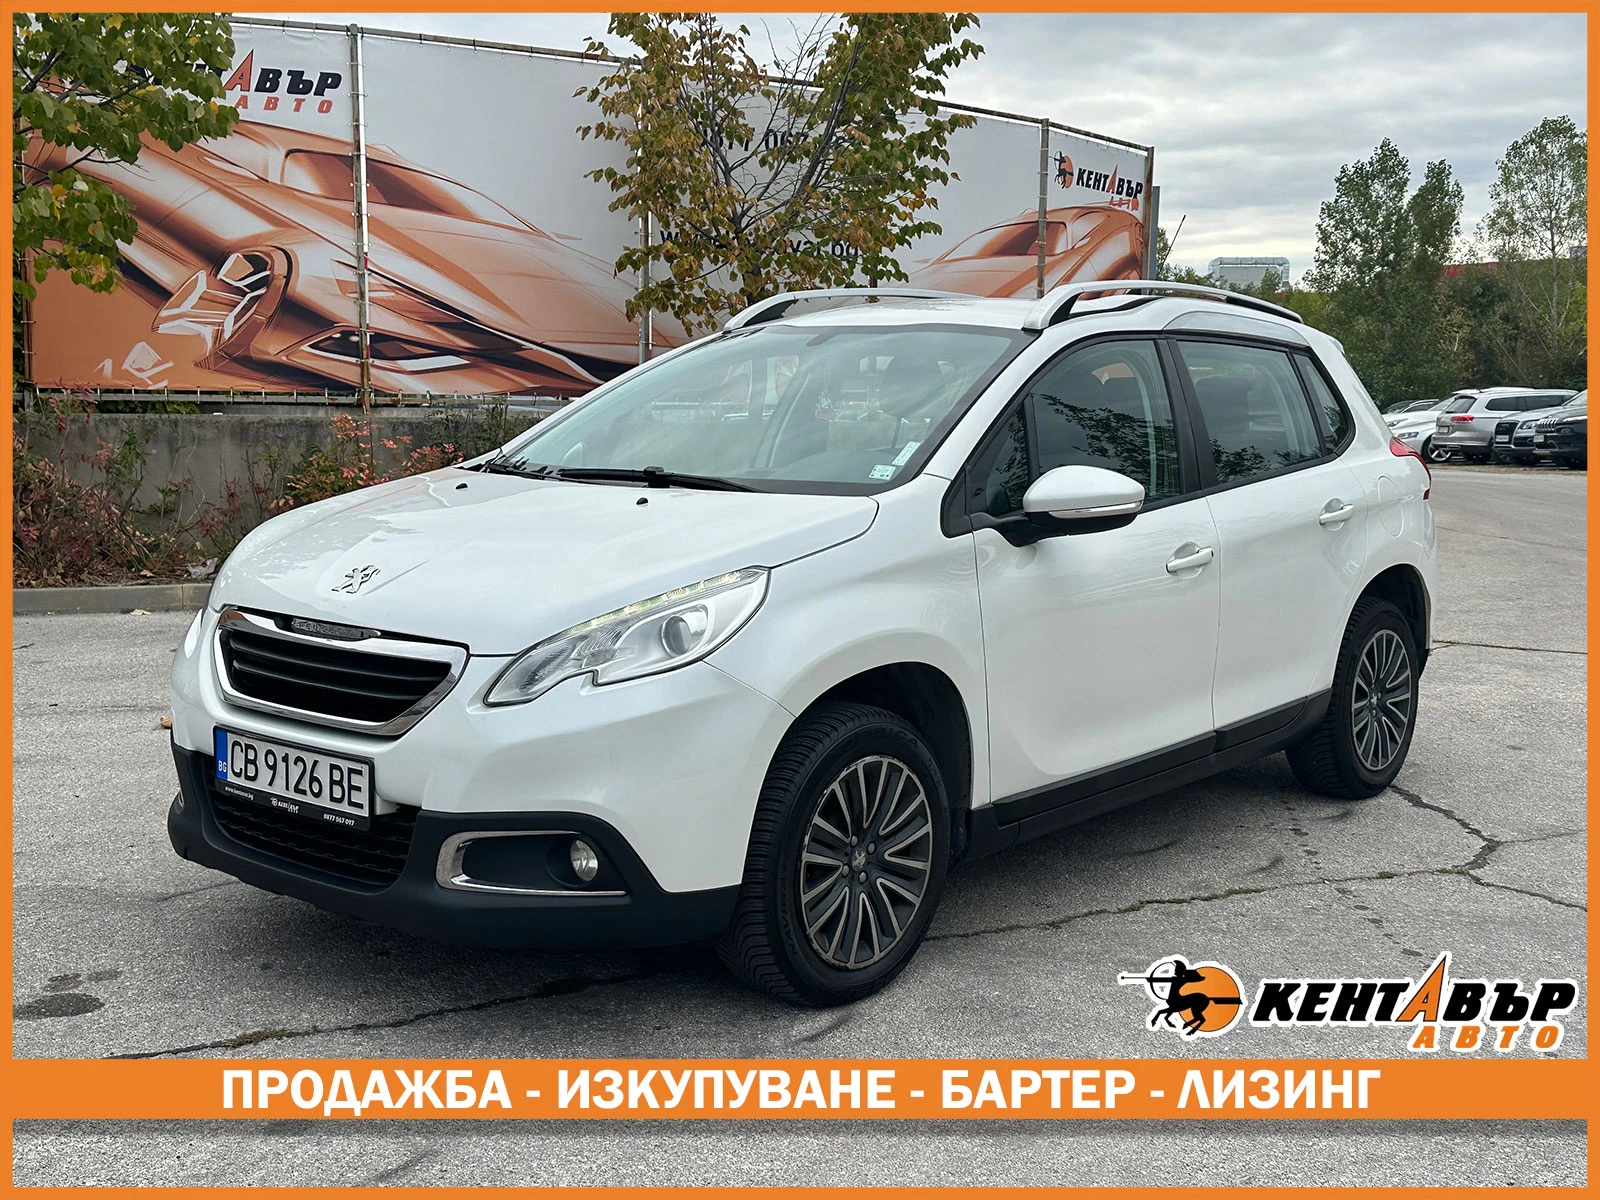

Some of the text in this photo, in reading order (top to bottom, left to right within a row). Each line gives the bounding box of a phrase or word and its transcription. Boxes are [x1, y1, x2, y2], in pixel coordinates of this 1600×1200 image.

[234, 94, 333, 114] АВТО
[1076, 163, 1143, 198] КЕНТАВЪР
[218, 760, 227, 773] BG
[264, 749, 323, 798] 9126
